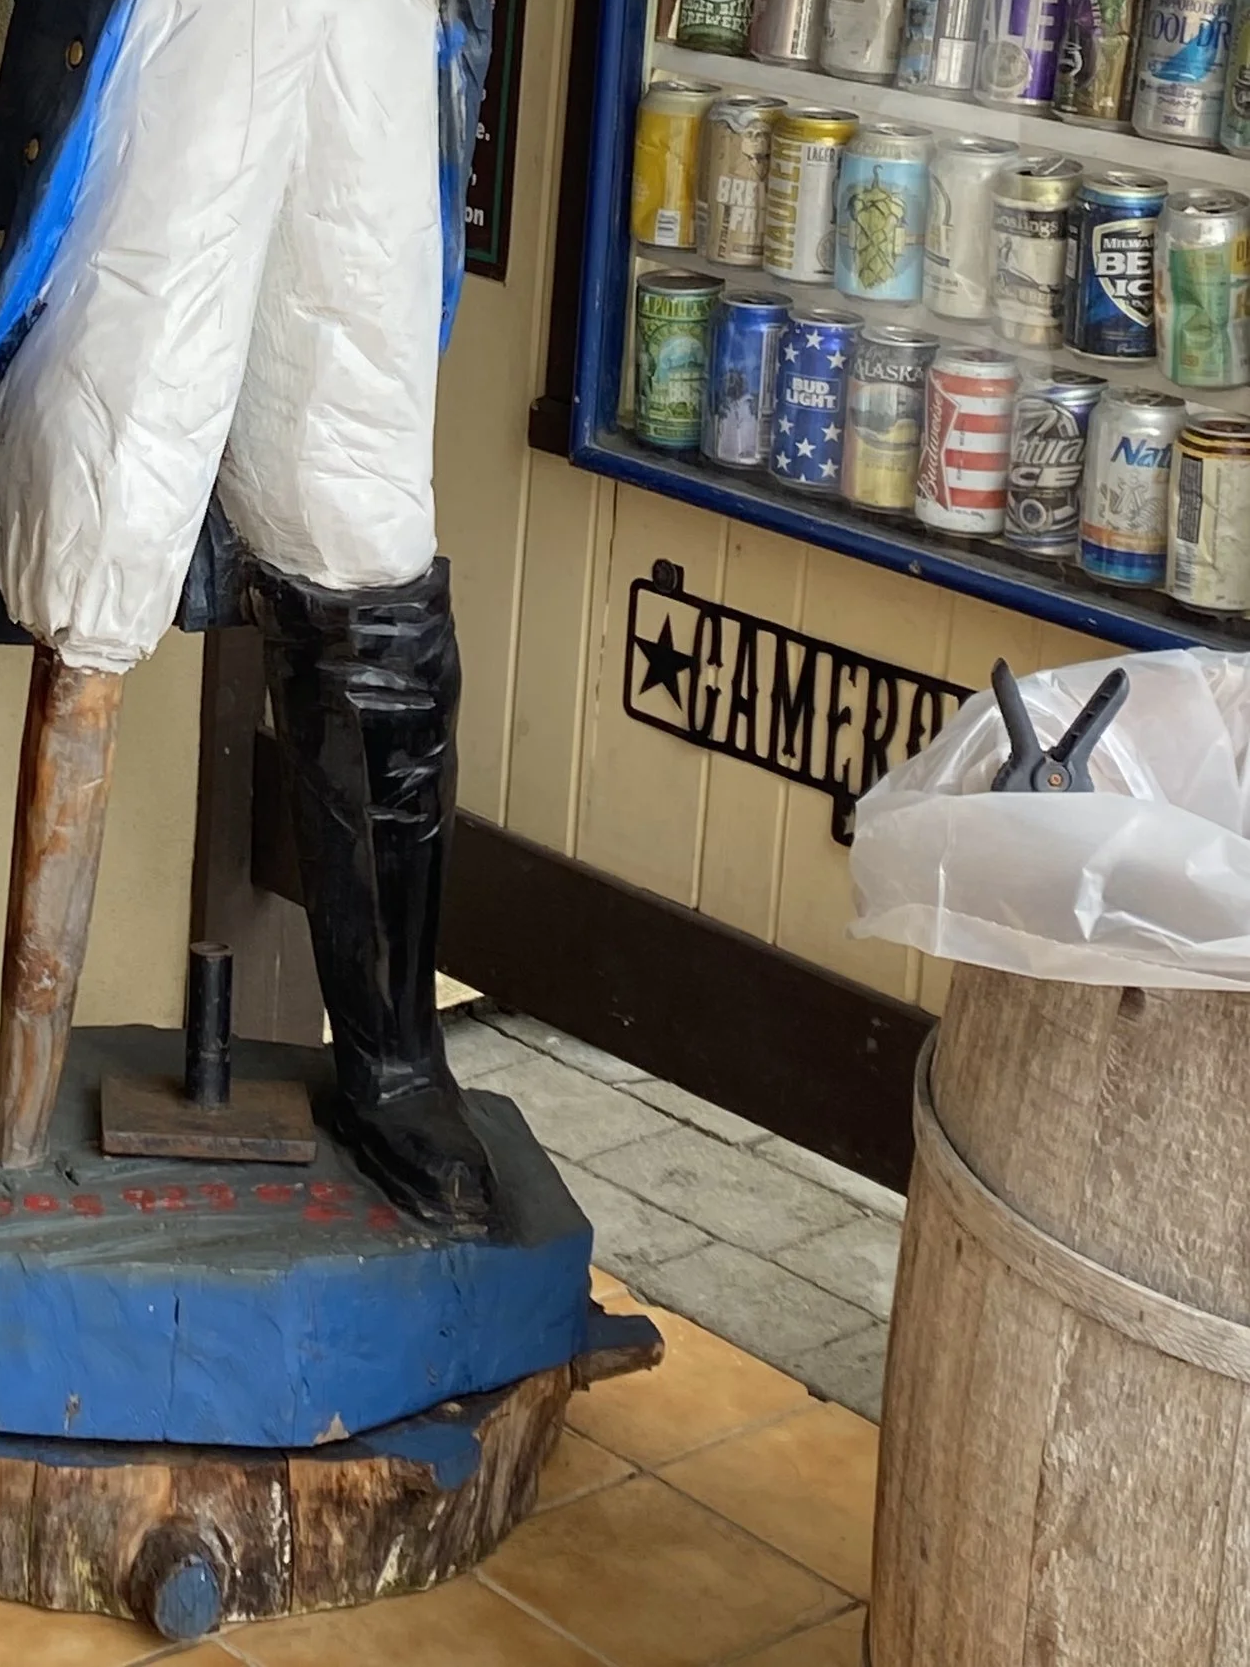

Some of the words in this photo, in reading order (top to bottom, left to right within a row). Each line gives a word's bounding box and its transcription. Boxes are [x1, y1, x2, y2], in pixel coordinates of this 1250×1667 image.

[806, 146, 836, 163] LAGER
[996, 214, 1060, 239] oslings
[792, 376, 831, 395] BUD
[785, 392, 837, 410] LIGHT
